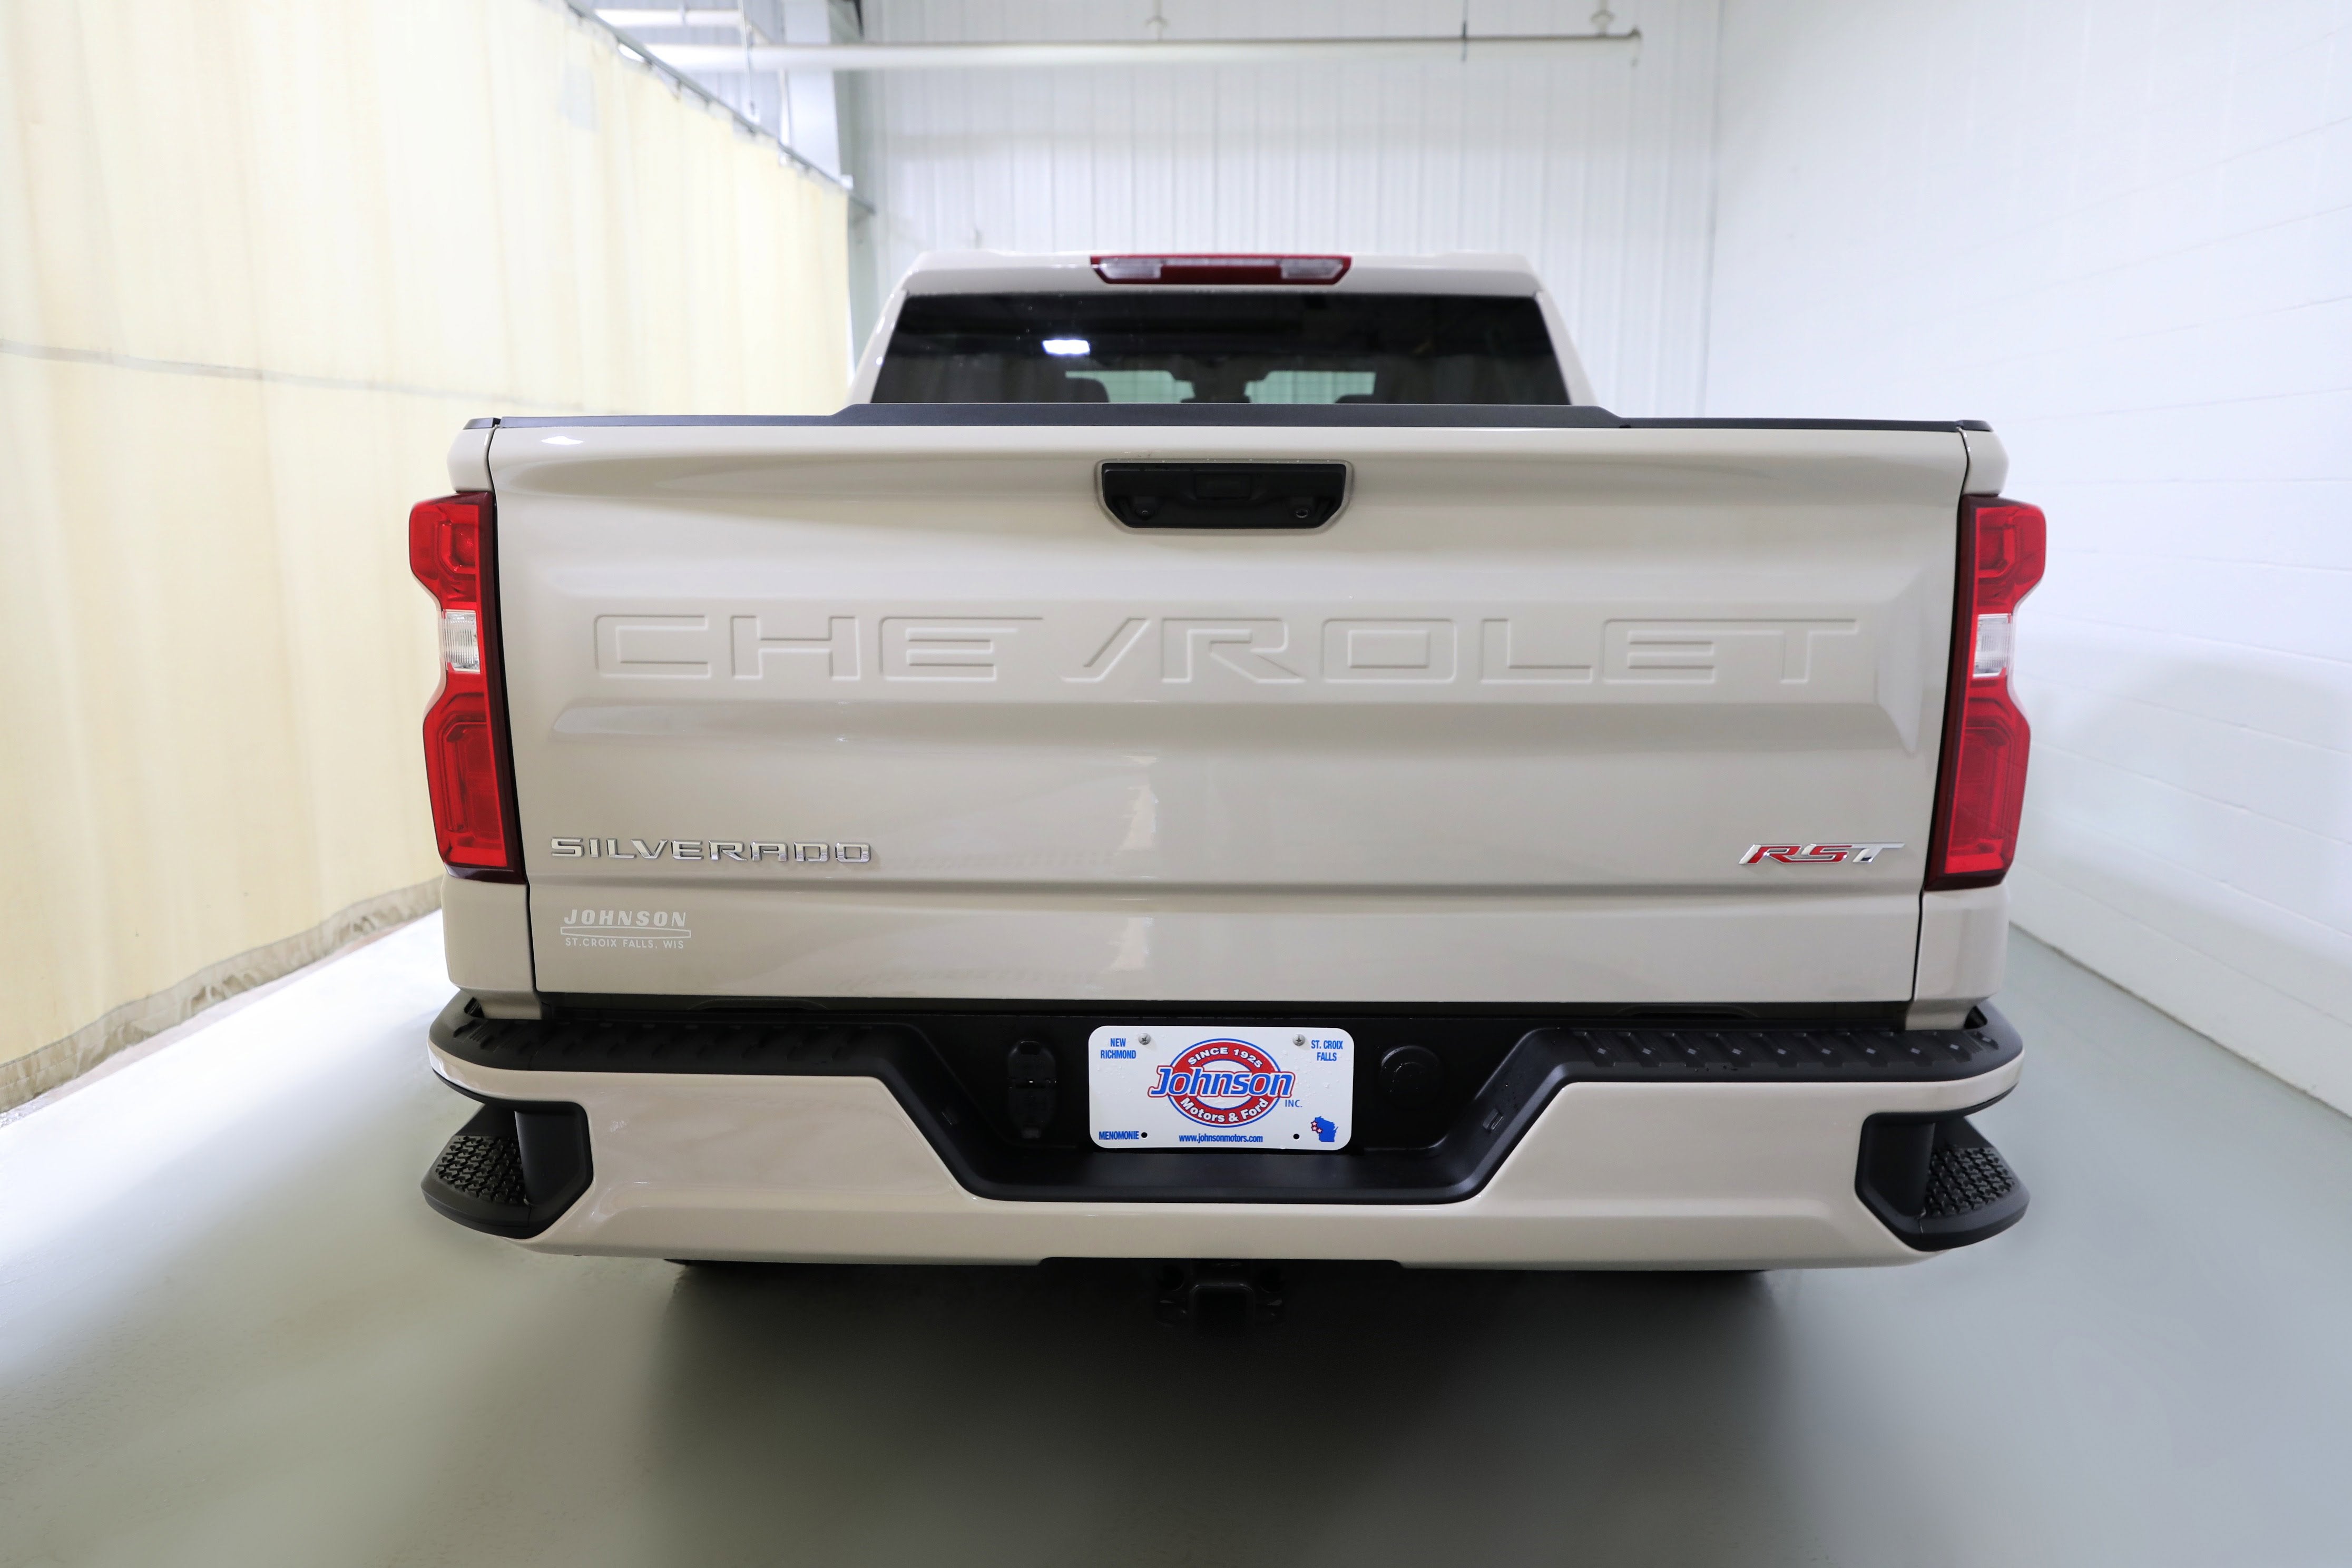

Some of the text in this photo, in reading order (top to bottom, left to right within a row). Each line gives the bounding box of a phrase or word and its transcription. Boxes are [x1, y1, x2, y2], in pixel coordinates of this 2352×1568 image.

[594, 614, 1859, 686] CHEVROLET
[551, 837, 872, 863] SILVERADO
[1738, 842, 1905, 865] RST
[564, 909, 686, 926] JOHNSON
[662, 940, 684, 949] WIS
[1110, 1038, 1126, 1047] NEW
[1311, 1040, 1343, 1050] ST. CROIX
[1100, 1050, 1136, 1059] RICHMOND
[1188, 1047, 1263, 1069] SINCE 1925
[1317, 1052, 1337, 1061] FALLS
[1148, 1065, 1295, 1097] Johnson
[1285, 1099, 1303, 1108] INC.
[1180, 1097, 1269, 1122] Motors & Ford
[1099, 1131, 1140, 1140] MENOMONIE
[1179, 1133, 1263, 1143] www.johnsonmotors.com
